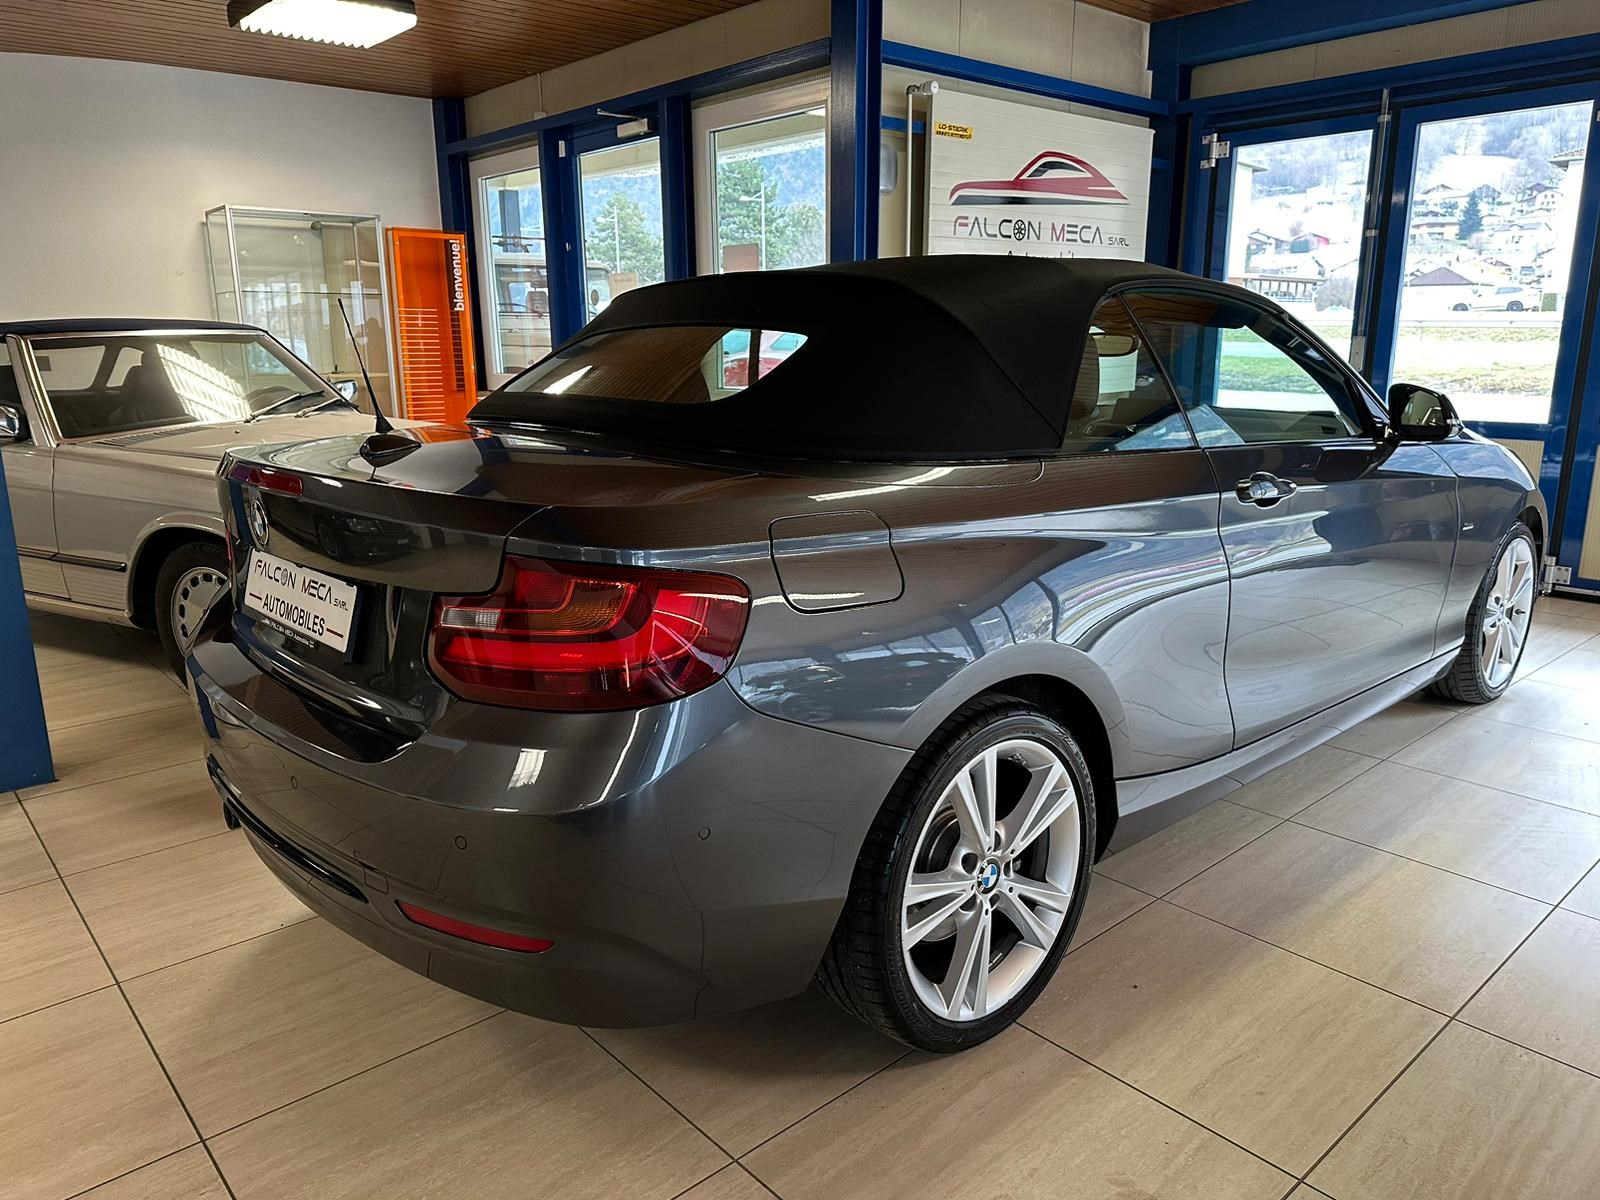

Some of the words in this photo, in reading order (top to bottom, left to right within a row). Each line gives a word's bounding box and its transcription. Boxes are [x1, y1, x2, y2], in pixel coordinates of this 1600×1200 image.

[953, 215, 1041, 241] FALCON
[1051, 222, 1103, 244] MECA
[1108, 236, 1129, 247] SARL
[449, 240, 465, 311] bienvenue!
[255, 559, 297, 589] FALCON
[301, 576, 332, 604] MECA
[262, 593, 325, 637] AUTOMOBILES
